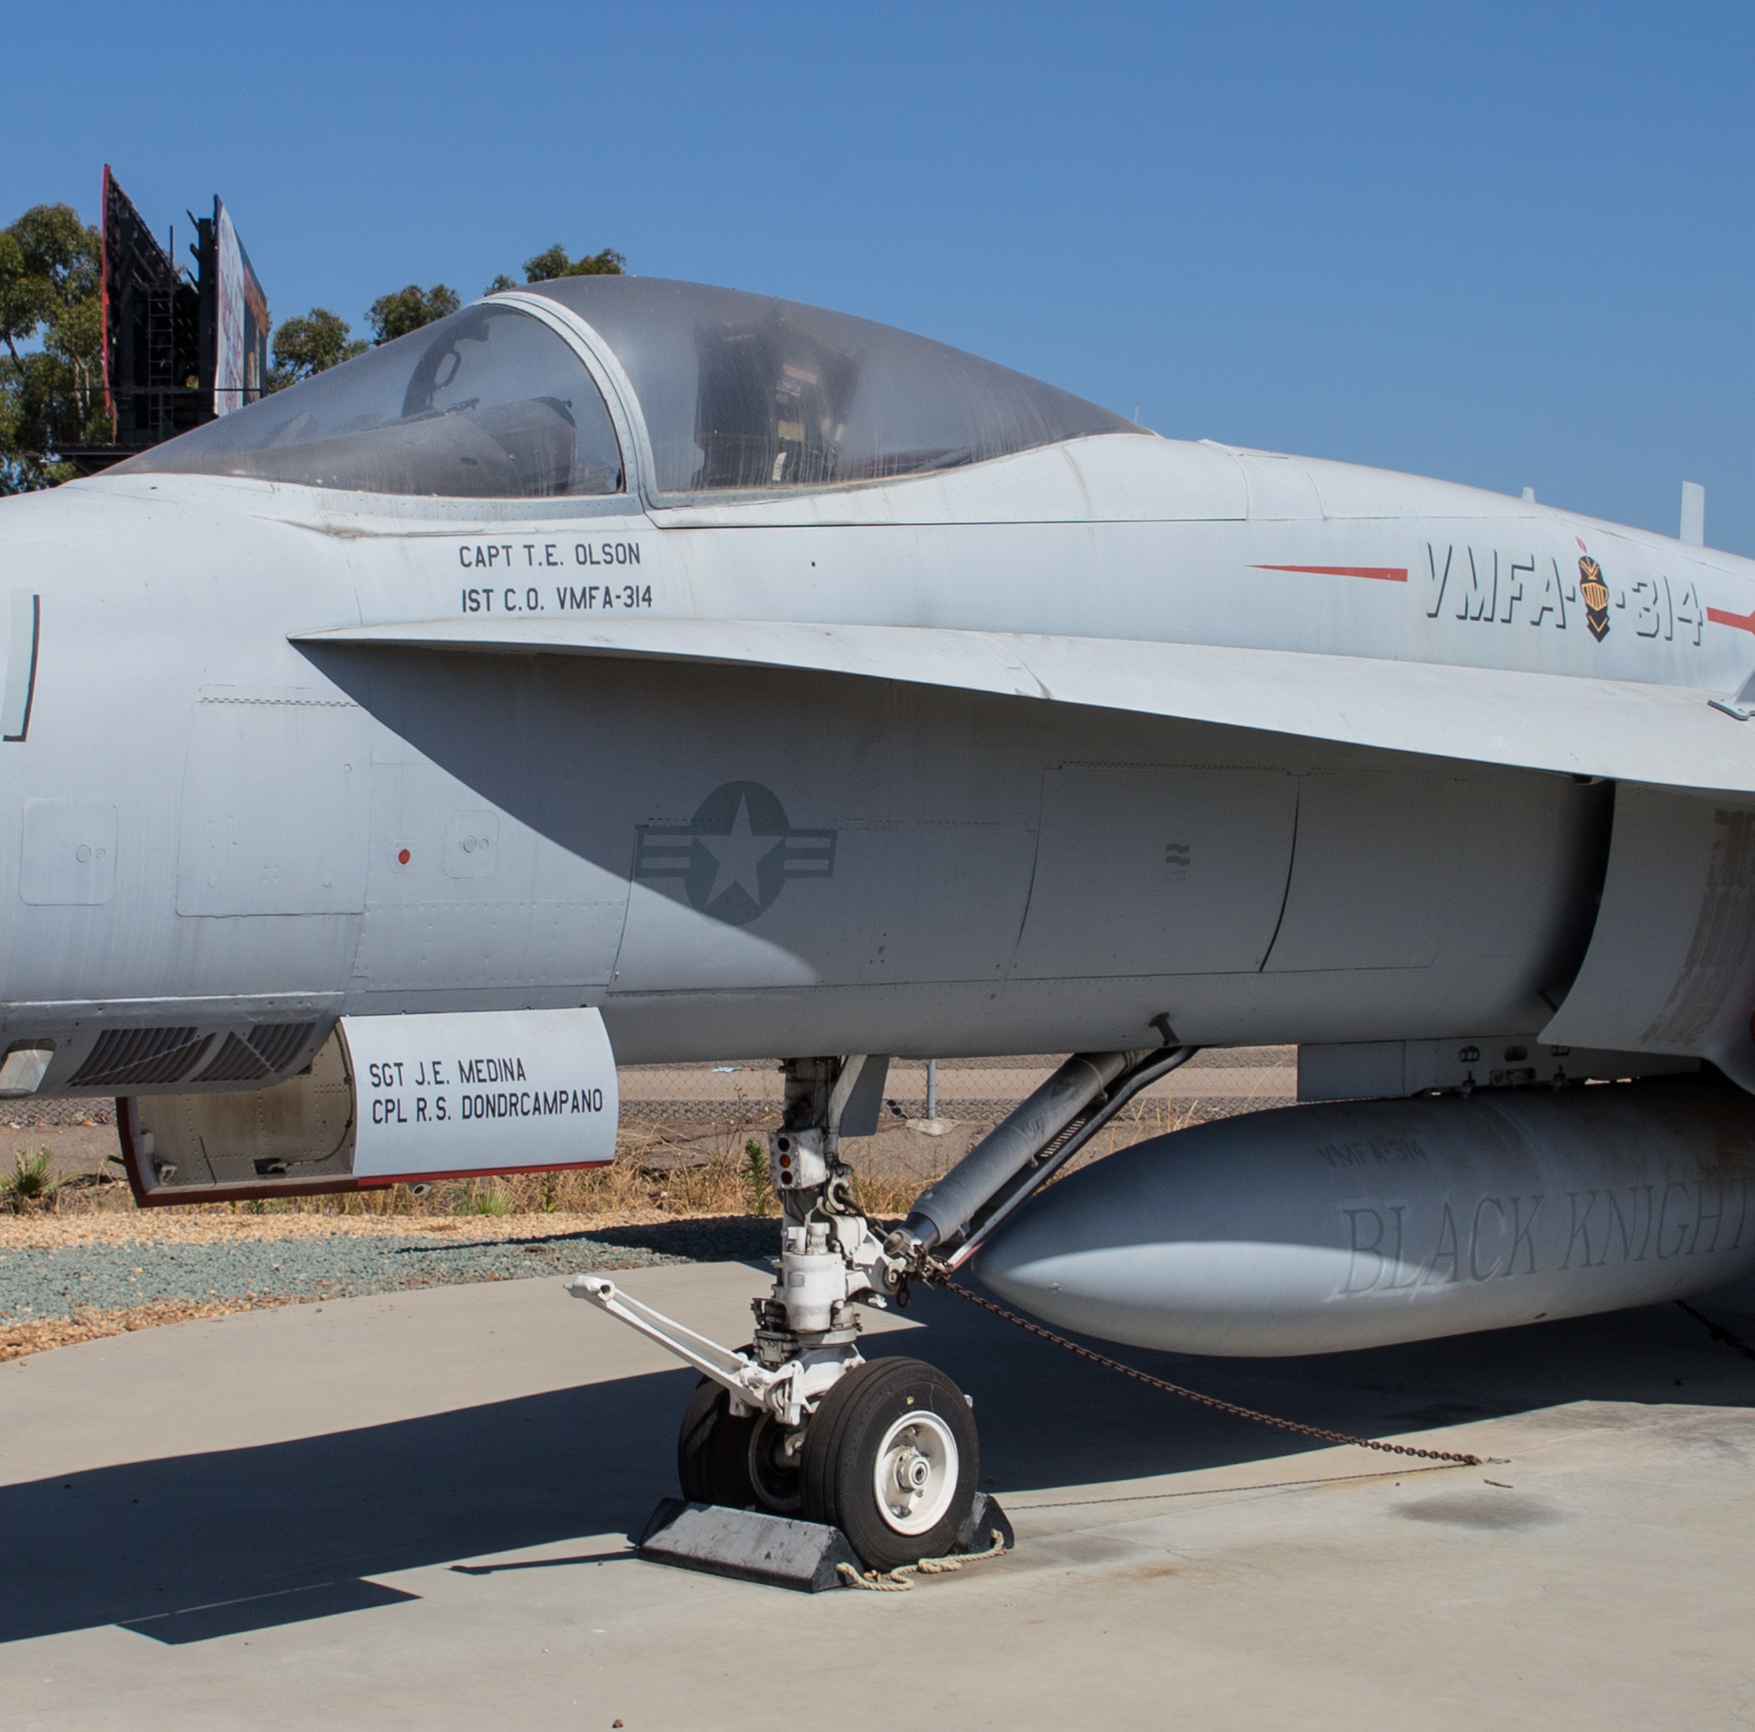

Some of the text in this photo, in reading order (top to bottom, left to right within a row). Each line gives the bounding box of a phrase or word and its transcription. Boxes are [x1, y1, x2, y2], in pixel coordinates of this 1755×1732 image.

[459, 542, 641, 568] CAPT T.E. OLSON
[504, 587, 544, 612] C.O.
[556, 585, 653, 610] VMFA-314
[369, 1057, 527, 1088] SGT J.E. MEDINA
[372, 1088, 603, 1124] CPL R.S. DONDRCAMPANO
[1316, 1139, 1428, 1168] VMFA-314
[1338, 1193, 1545, 1295] BLACK
